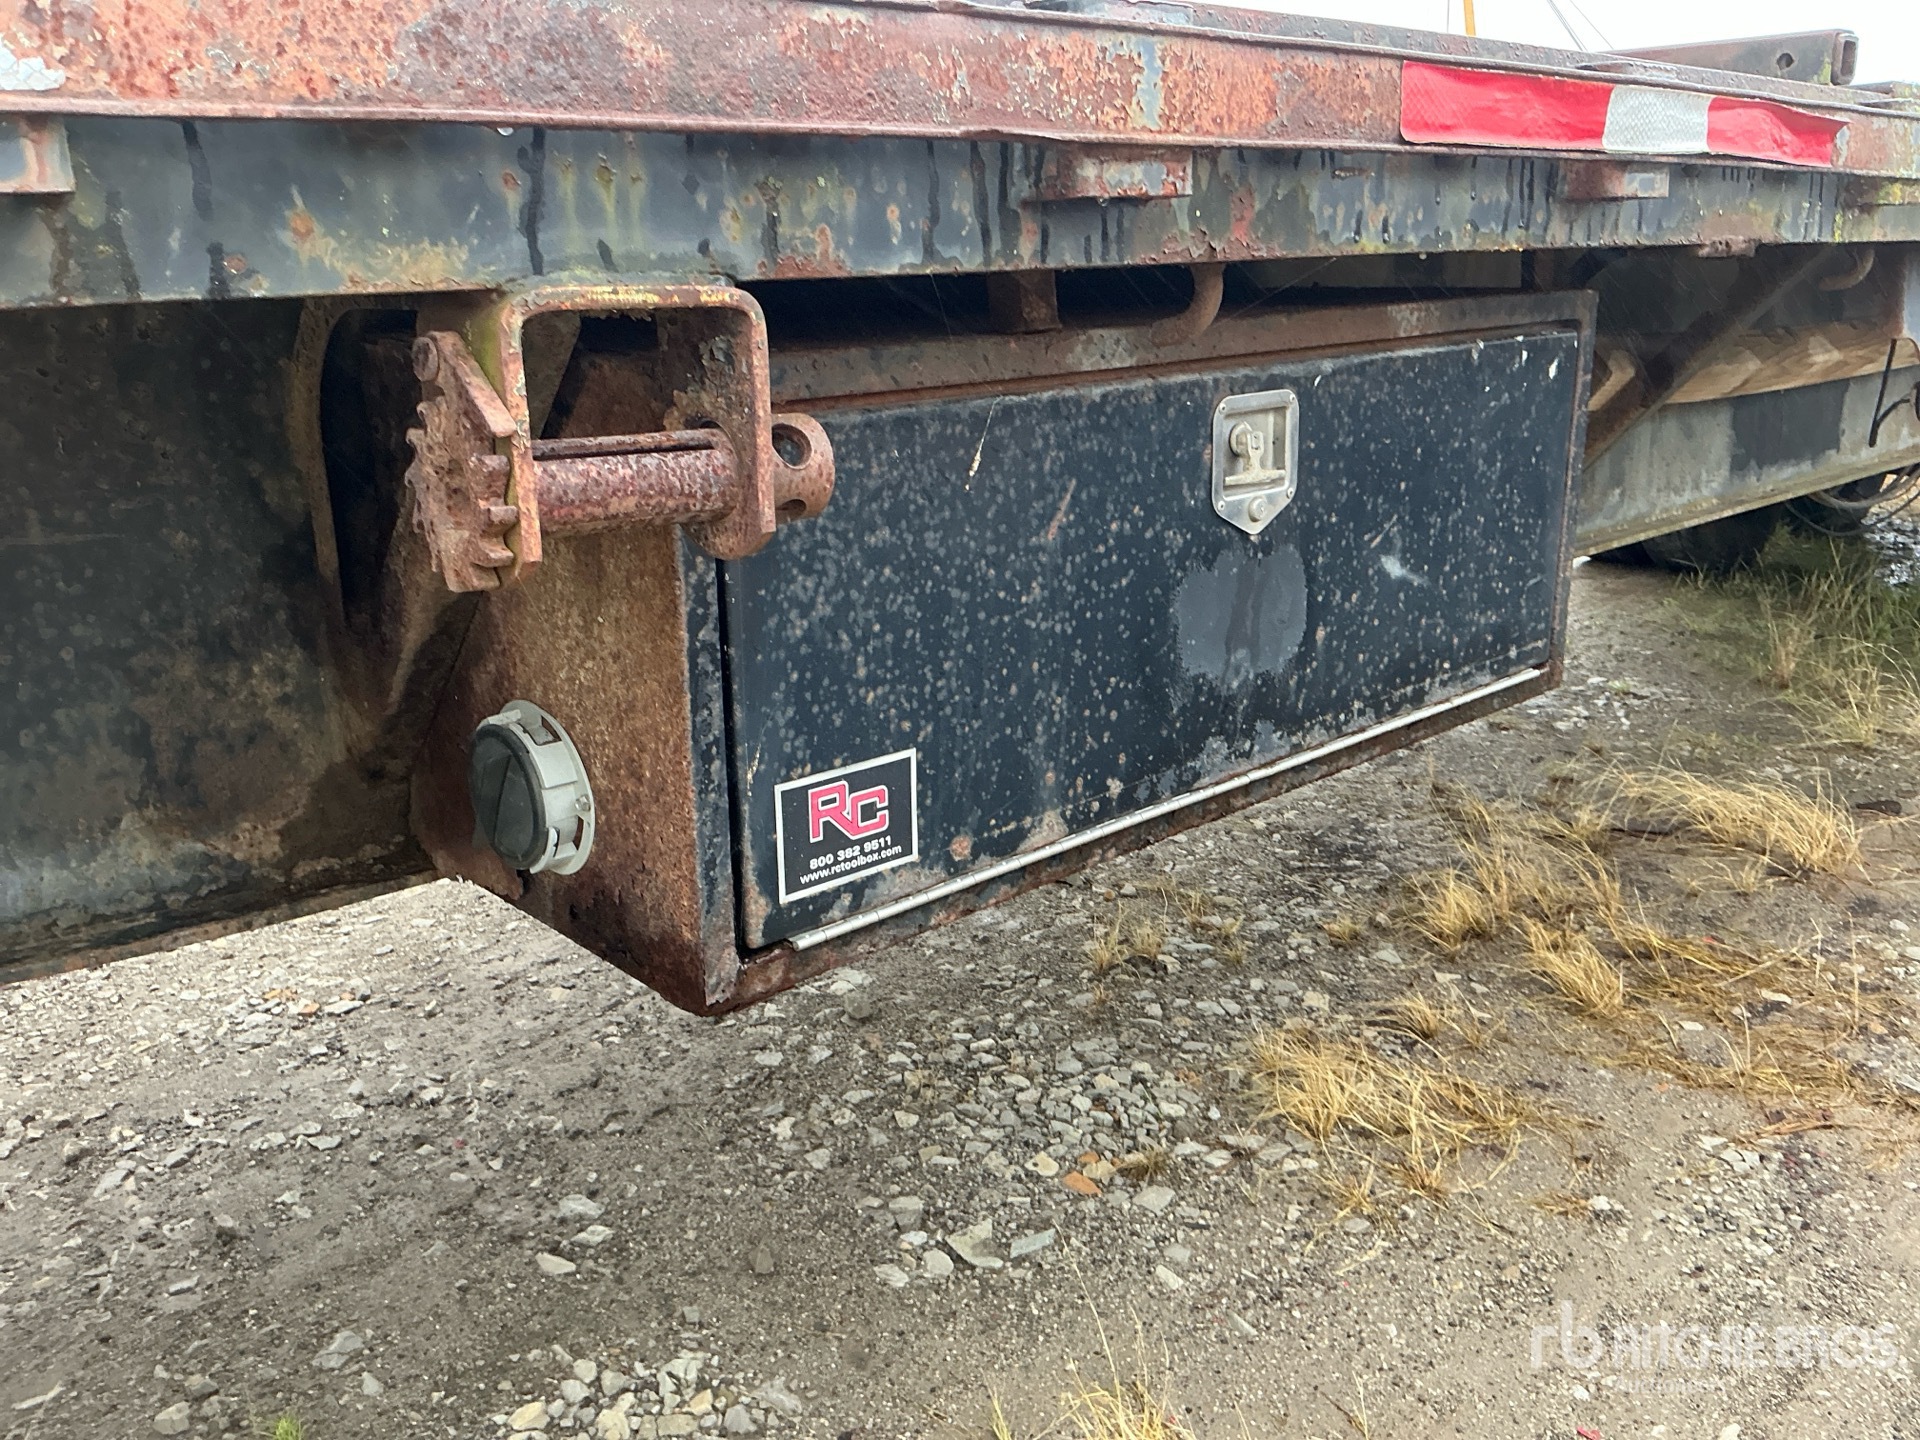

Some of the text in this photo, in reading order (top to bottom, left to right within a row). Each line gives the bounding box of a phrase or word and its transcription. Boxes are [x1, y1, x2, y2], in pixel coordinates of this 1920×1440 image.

[808, 780, 889, 844] RC
[799, 845, 902, 885] www.rctoolbox.com
[809, 835, 892, 870] 800 382 9511
